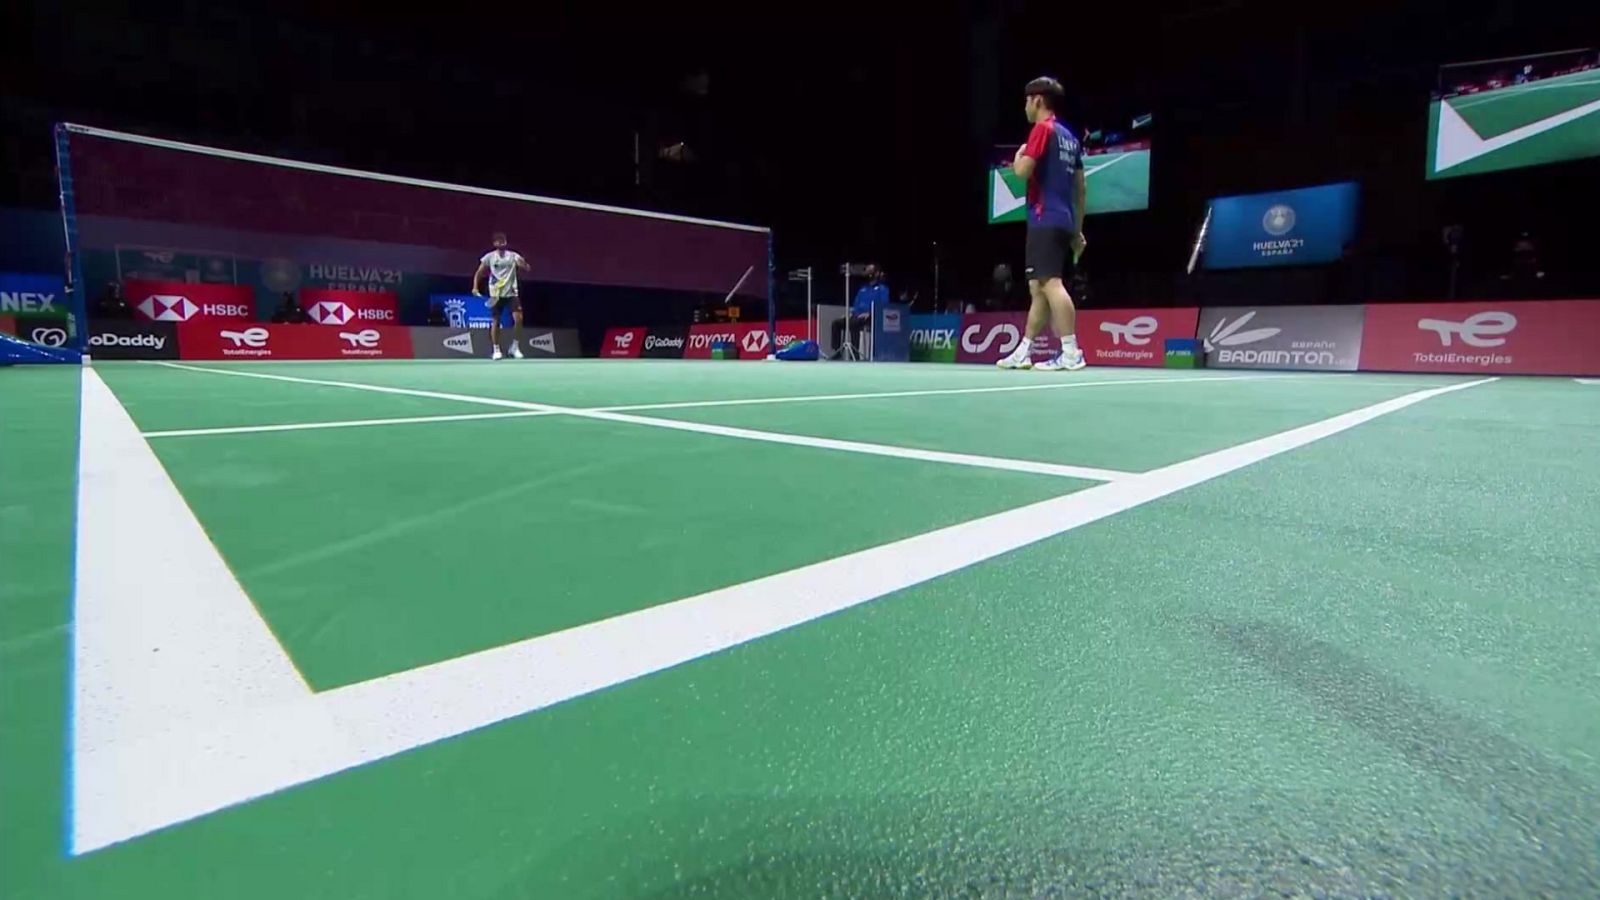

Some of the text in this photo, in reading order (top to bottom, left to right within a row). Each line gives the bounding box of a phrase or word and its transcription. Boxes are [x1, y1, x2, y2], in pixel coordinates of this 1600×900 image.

[203, 303, 249, 317] HSBC
[357, 308, 394, 320] HSBC
[88, 332, 167, 350] oDaddy
[655, 338, 684, 349] GoDaddy
[222, 348, 272, 357] TotalEnergies
[1096, 349, 1153, 360] TotalEnergies
[1413, 352, 1512, 366] TotalEnergies
